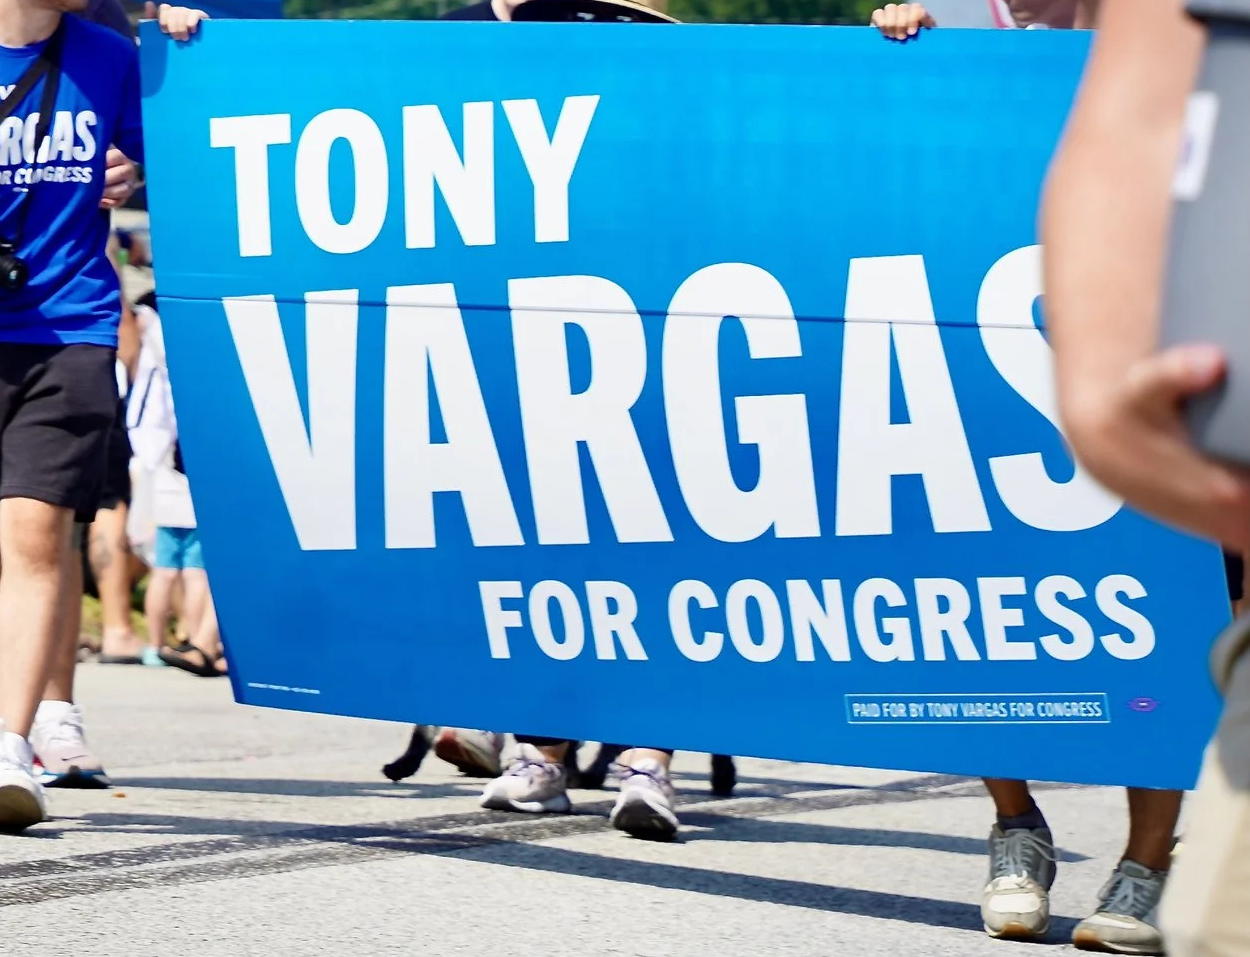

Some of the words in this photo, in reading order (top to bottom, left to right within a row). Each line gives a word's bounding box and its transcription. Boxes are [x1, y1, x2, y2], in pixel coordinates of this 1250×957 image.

[210, 95, 600, 257] TONY
[223, 244, 1126, 551] VARGAS
[479, 580, 648, 662] FOR
[668, 574, 1156, 662] CONGRESS
[852, 703, 881, 717] PAID
[882, 703, 907, 717] FOR
[908, 703, 925, 717] BY
[926, 703, 958, 717] TONY
[960, 702, 1008, 717] VARGAS
[1009, 702, 1035, 717] FOR
[1037, 701, 1102, 717] CONGRESS
